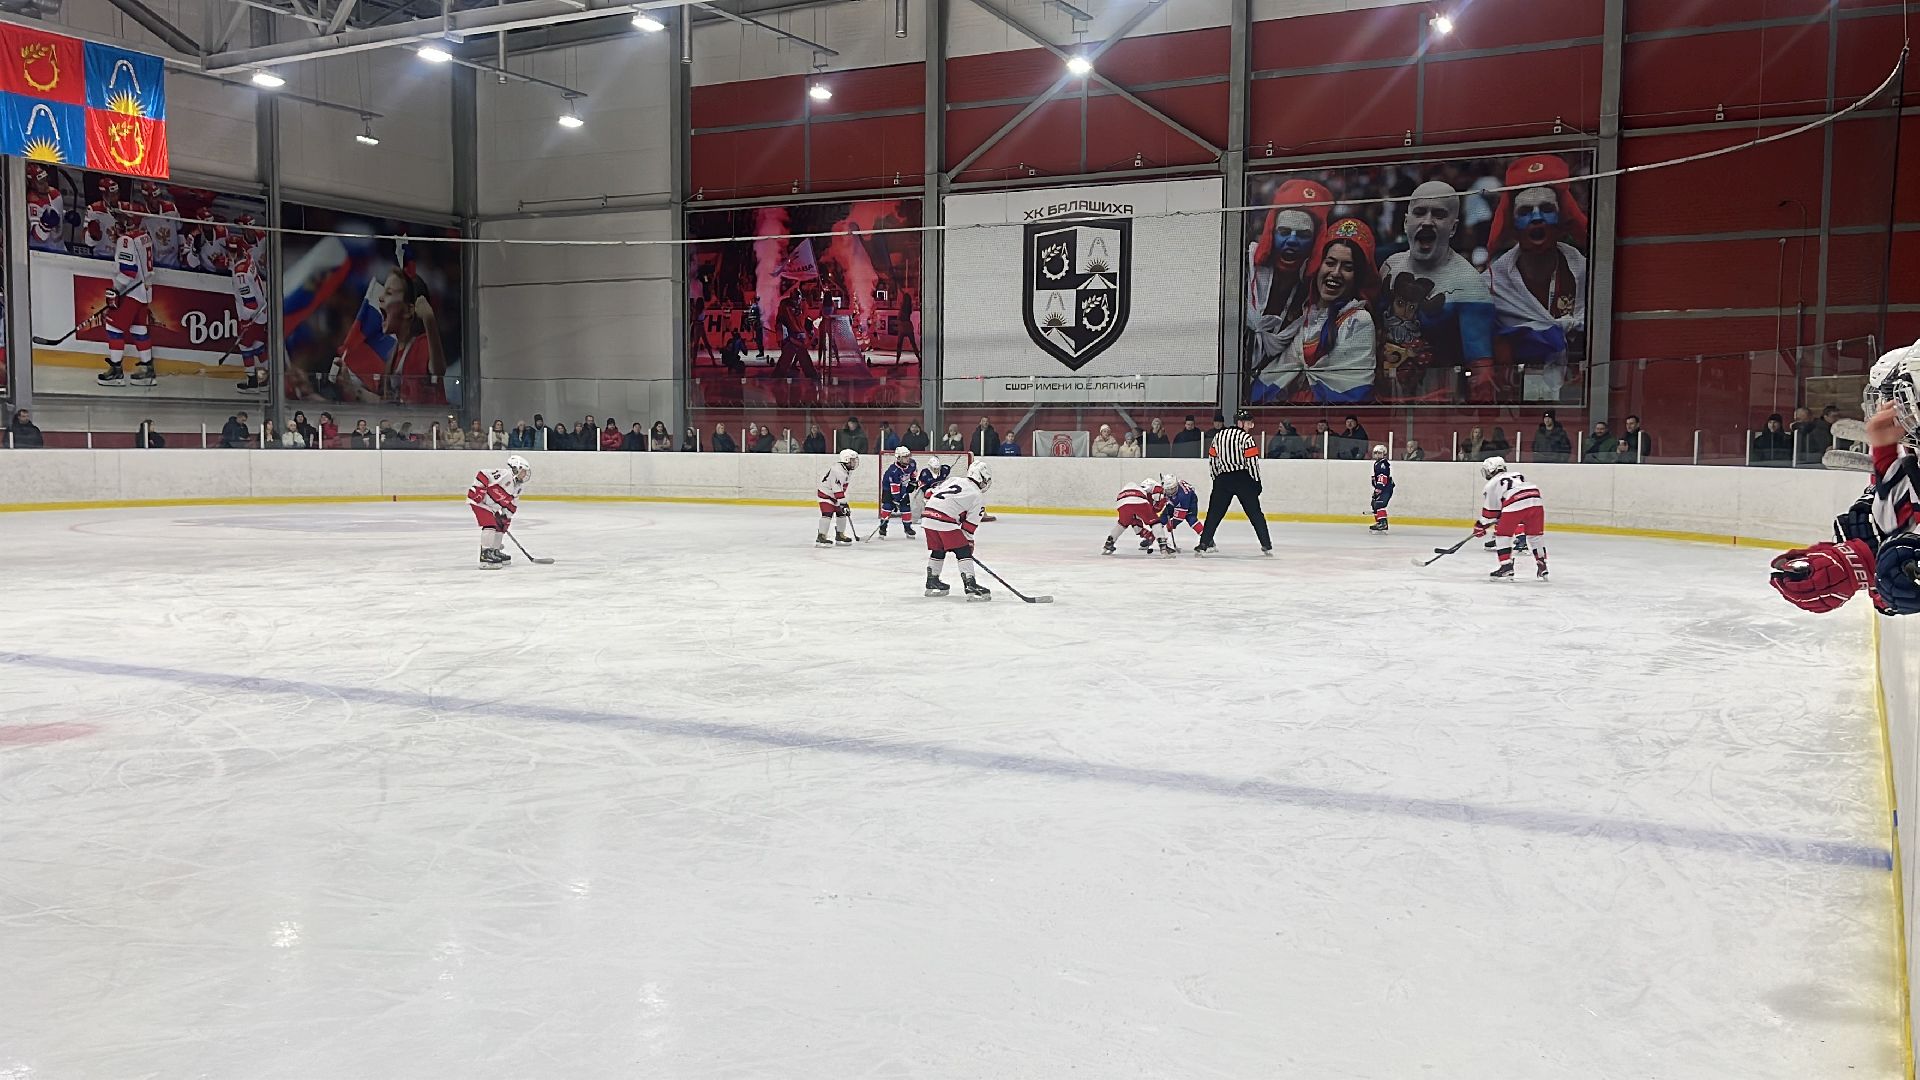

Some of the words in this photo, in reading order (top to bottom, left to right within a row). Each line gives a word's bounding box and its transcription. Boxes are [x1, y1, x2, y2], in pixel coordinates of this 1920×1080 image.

[1023, 207, 1044, 220] ХК
[1047, 200, 1134, 216] БАЛАШИХА
[181, 309, 238, 344] Boh
[934, 484, 962, 499] 2
